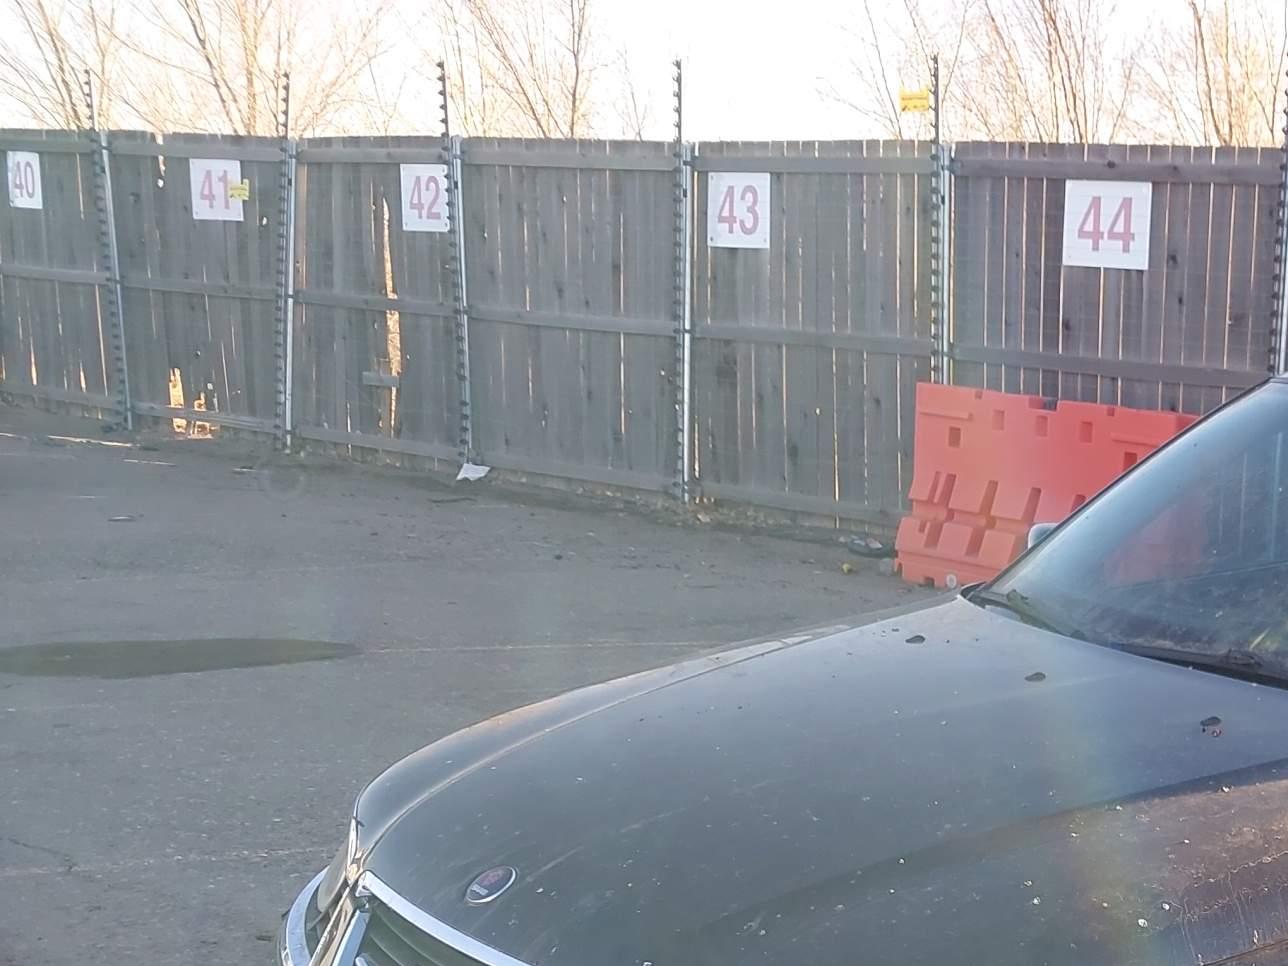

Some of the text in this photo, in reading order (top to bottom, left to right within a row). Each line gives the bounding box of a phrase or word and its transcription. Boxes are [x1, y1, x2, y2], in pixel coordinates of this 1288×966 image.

[14, 160, 36, 199] 40
[200, 169, 230, 210] 41
[408, 176, 441, 220] 42
[717, 186, 760, 235] 43
[1077, 196, 1136, 253] 44
